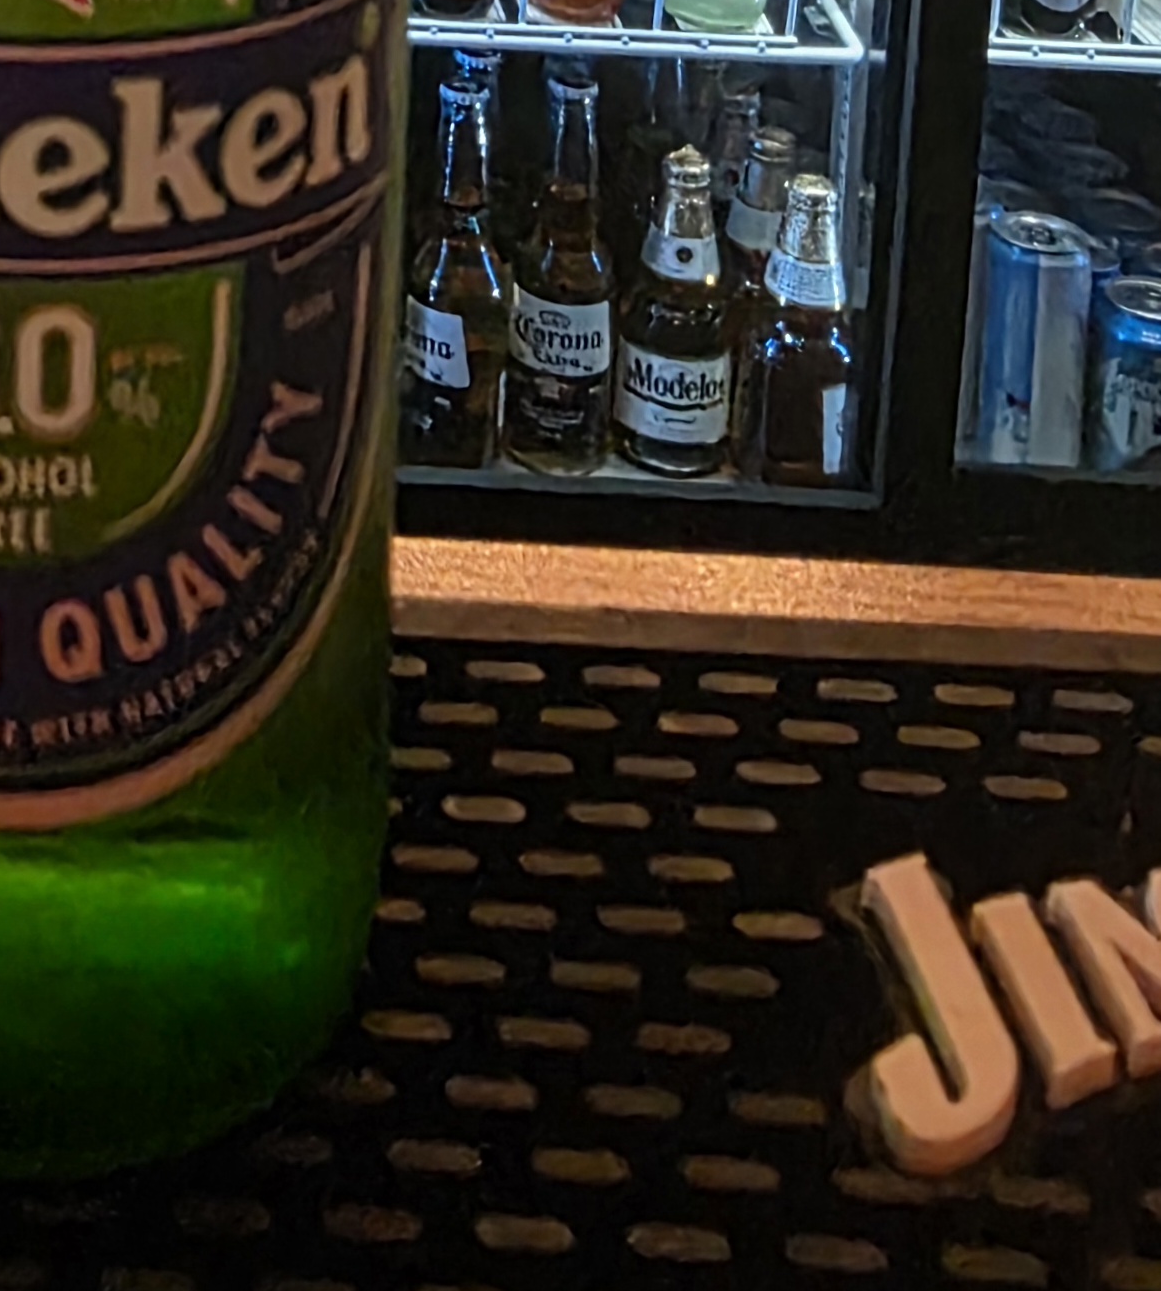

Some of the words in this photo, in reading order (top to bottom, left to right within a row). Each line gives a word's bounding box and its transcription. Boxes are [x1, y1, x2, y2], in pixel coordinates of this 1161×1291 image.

[514, 315, 604, 351] Corona
[633, 357, 719, 402] Modelo
[41, 381, 324, 685] QUALITY
